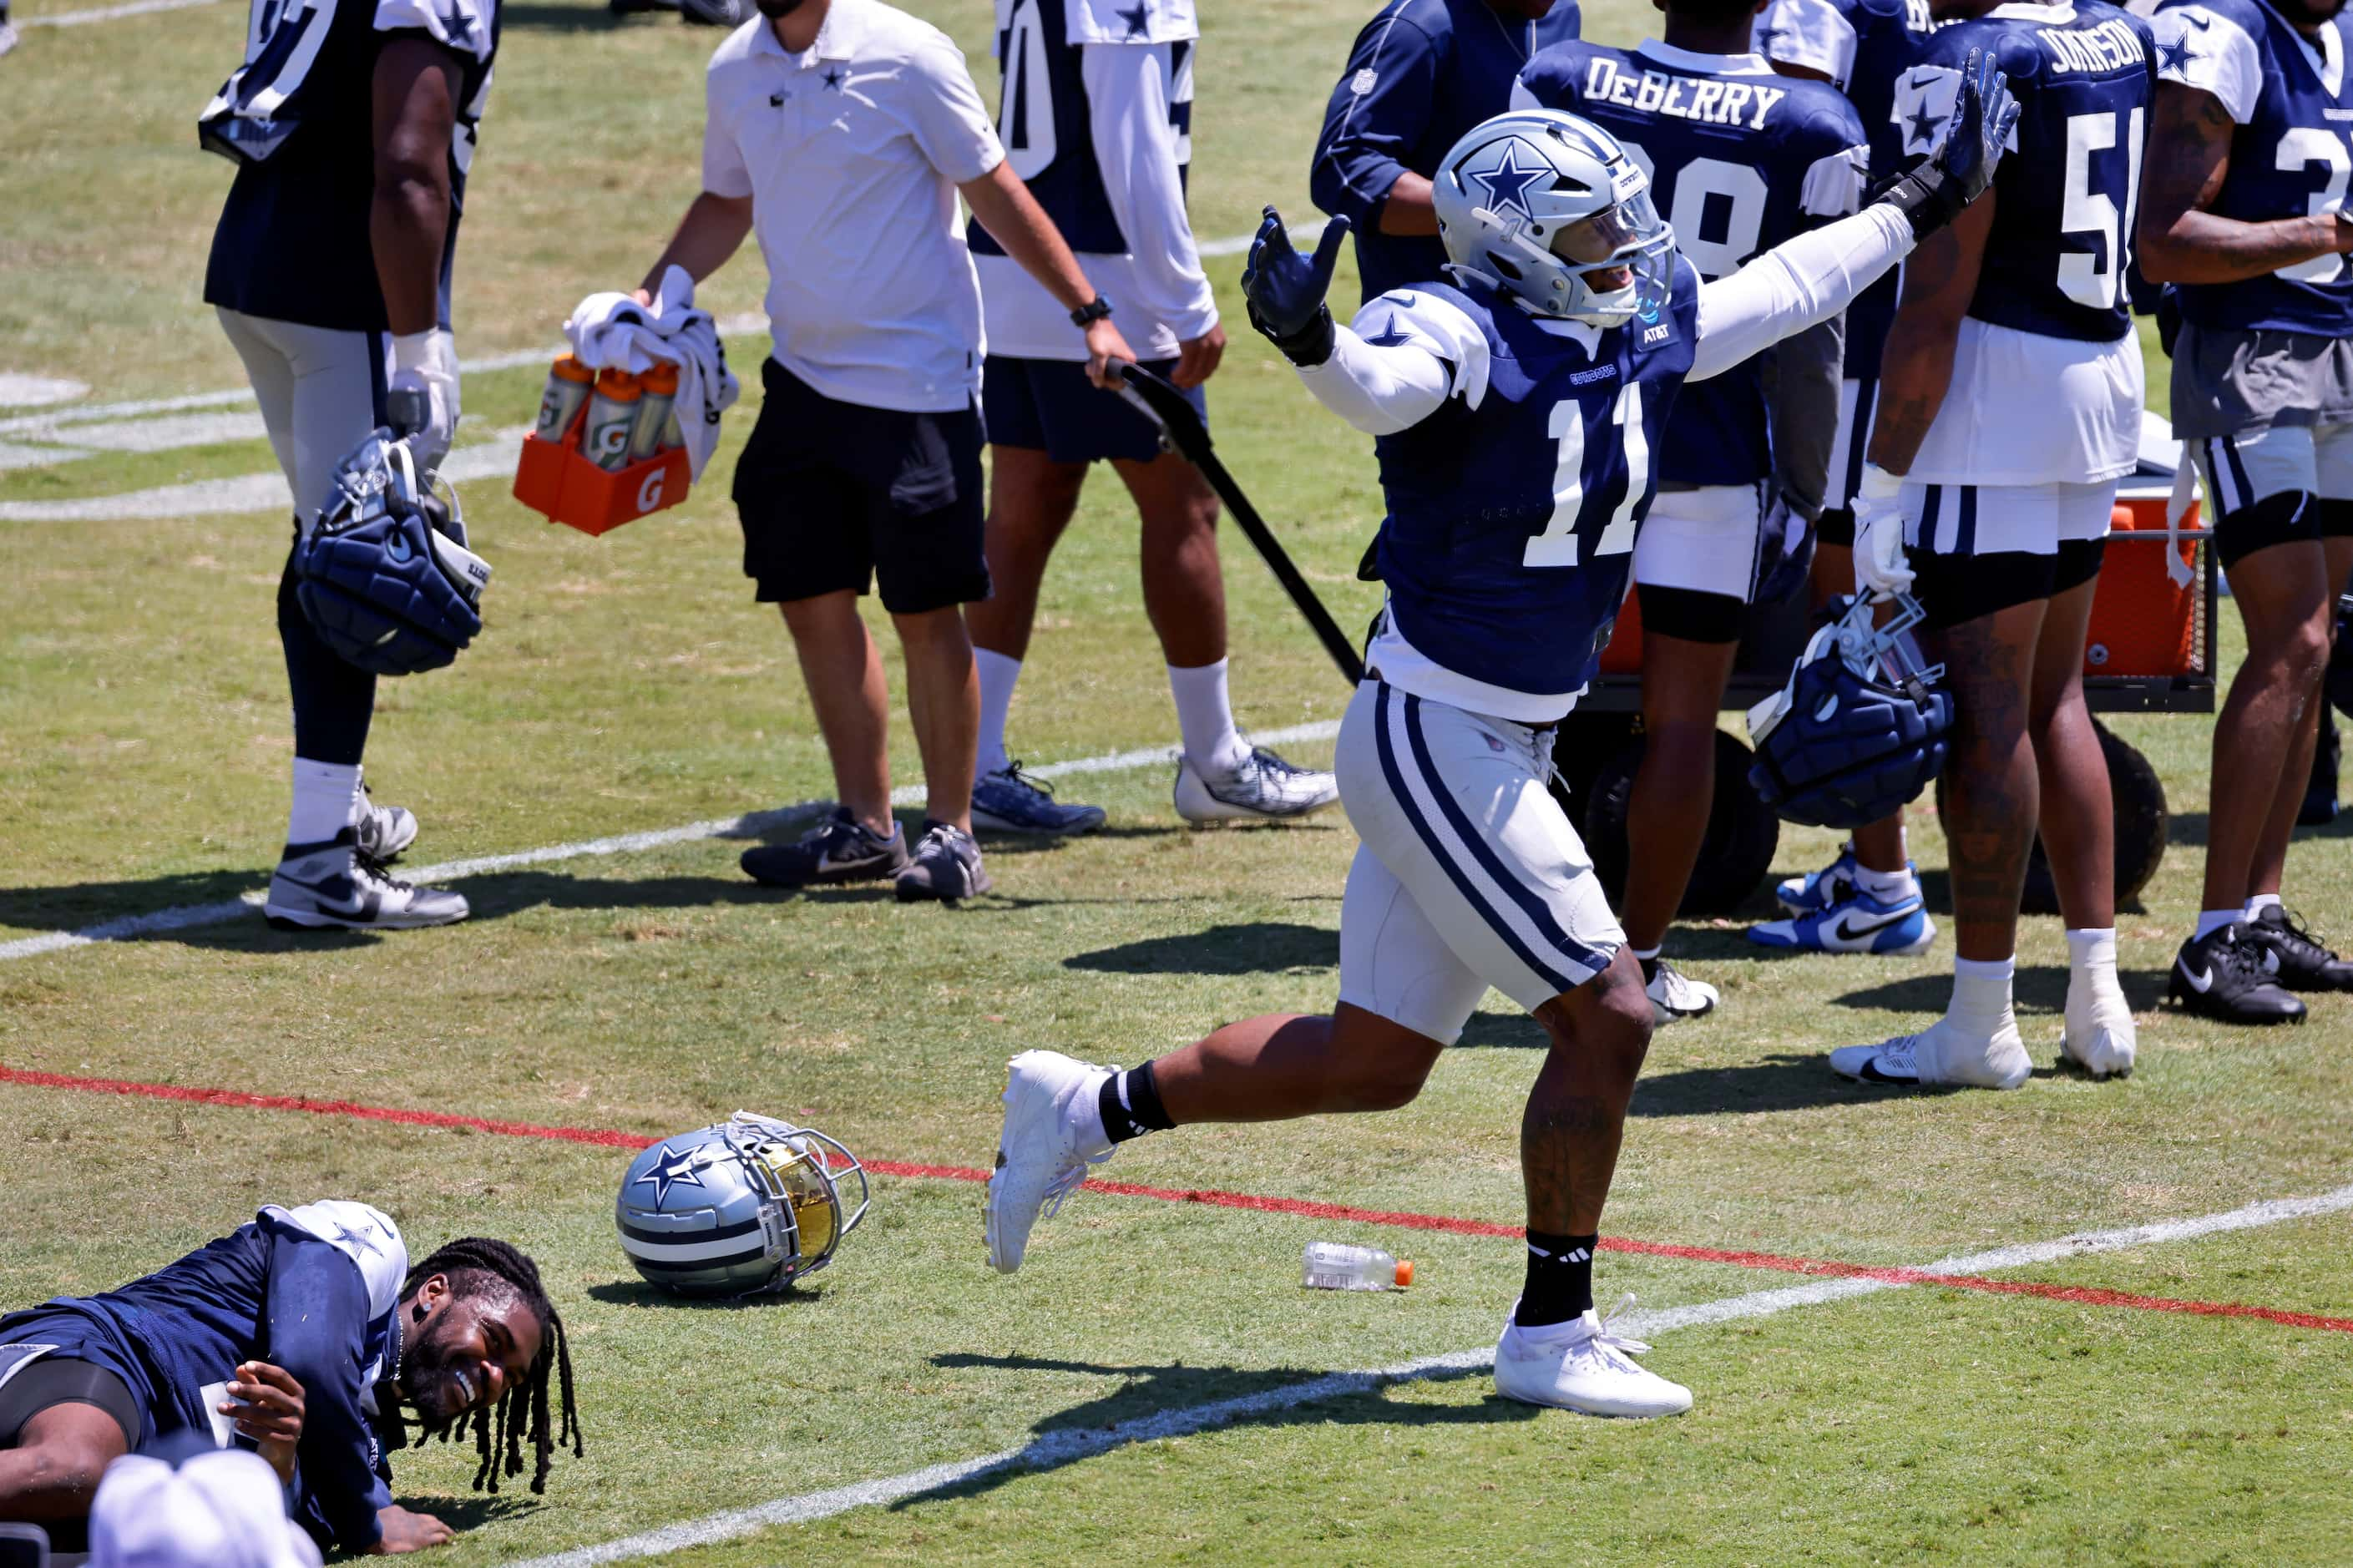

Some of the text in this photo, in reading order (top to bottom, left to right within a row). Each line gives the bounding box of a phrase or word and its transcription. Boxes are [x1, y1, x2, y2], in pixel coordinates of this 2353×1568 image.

[1583, 57, 1784, 130] DeBERRY
[1643, 324, 1669, 343] AT&T
[1570, 364, 1617, 385] COWBOYS
[598, 423, 628, 455] G
[637, 466, 666, 513] G
[1523, 380, 1649, 567] 11
